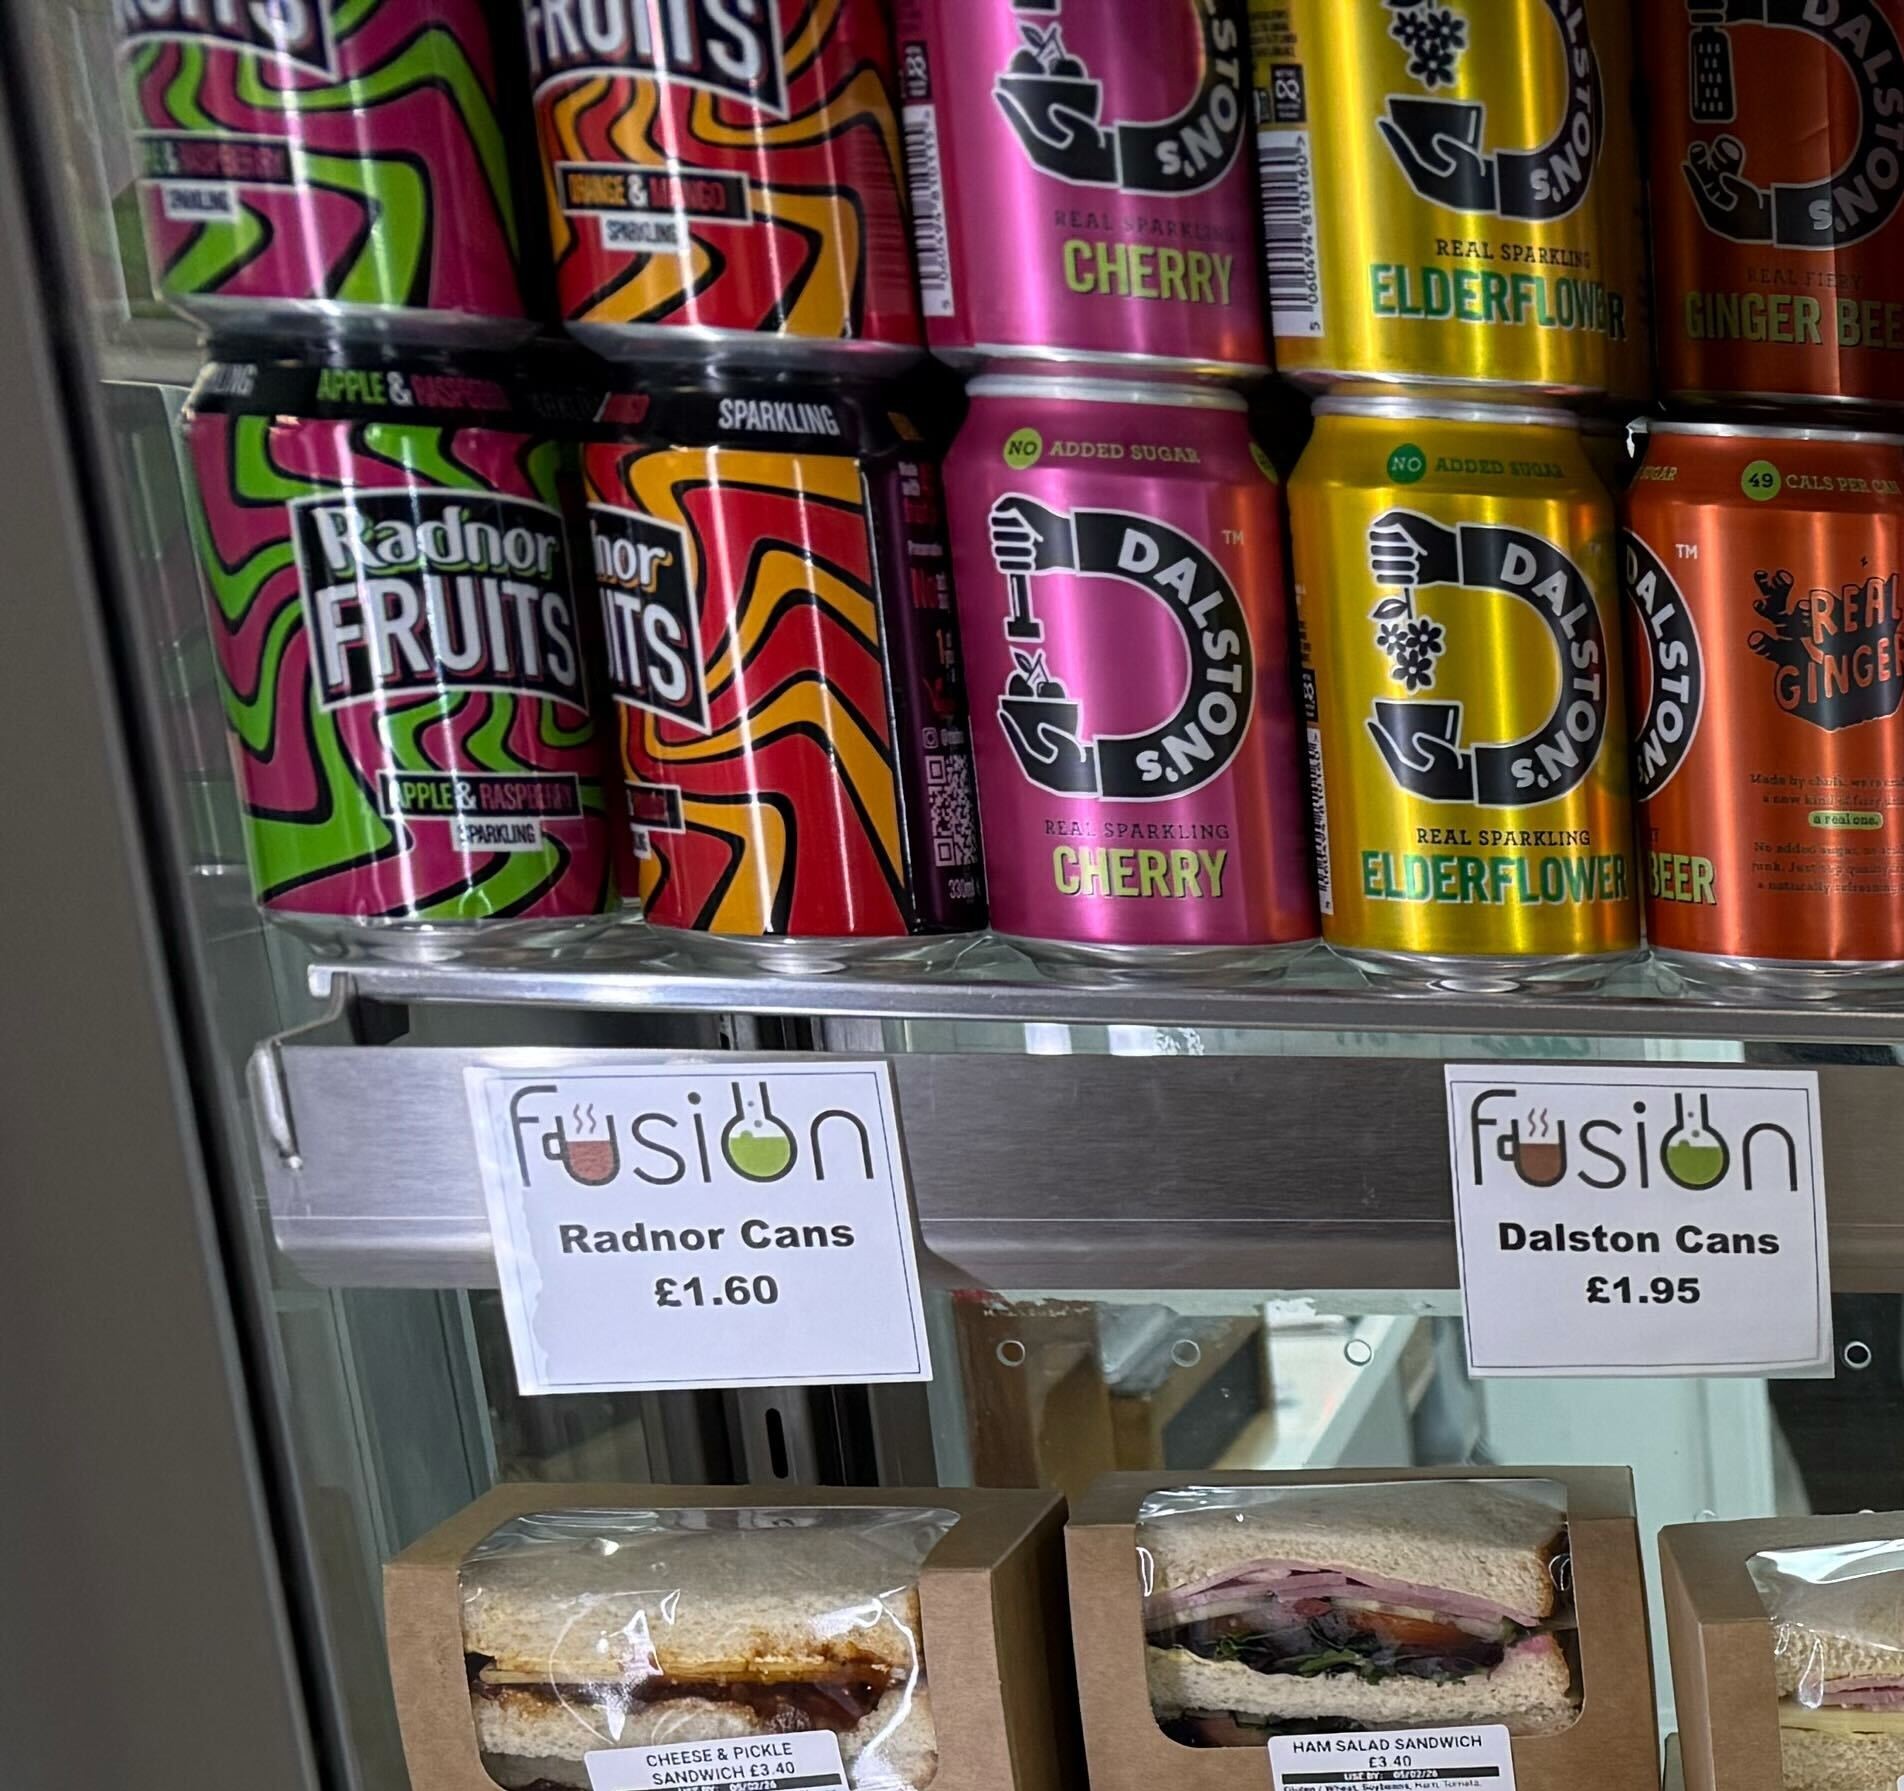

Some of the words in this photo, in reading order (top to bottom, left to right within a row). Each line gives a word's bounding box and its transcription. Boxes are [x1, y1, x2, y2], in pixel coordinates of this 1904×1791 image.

[1436, 239, 1494, 259] REAL
[1500, 242, 1590, 268] SPARKLING
[1063, 238, 1233, 305] CHERRY
[1683, 289, 1821, 345] GINGER
[719, 399, 840, 436] SPARKLING
[1009, 441, 1036, 458] NO
[1050, 442, 1124, 461] ADDED
[1130, 444, 1201, 464] SUGAR
[312, 503, 557, 580] Radnor
[314, 574, 577, 692] FRUITS
[1045, 819, 1096, 838] REAL
[1103, 820, 1229, 841] SPARKLING
[1417, 827, 1473, 846] REAL
[1479, 828, 1591, 847] SPARKLING
[1053, 845, 1227, 899] CHERRY
[1362, 851, 1627, 903] ELDERFLOWER
[560, 1221, 724, 1253] Radnor
[741, 1219, 855, 1250] Cans
[1500, 1223, 1659, 1253] Dalston
[1676, 1225, 1780, 1255] Cans
[655, 1275, 779, 1307] £1.60
[1586, 1276, 1700, 1304] £1.95
[647, 1752, 711, 1767] CHEESE
[718, 1749, 728, 1760] &
[734, 1743, 792, 1758] PICKLE
[1293, 1741, 1330, 1753] HAM
[1336, 1739, 1390, 1752] SALAD
[1395, 1735, 1482, 1749] SANDWICH
[652, 1766, 743, 1785] SANDWICH
[750, 1762, 795, 1777] £3.40
[1368, 1756, 1412, 1768] £3.40
